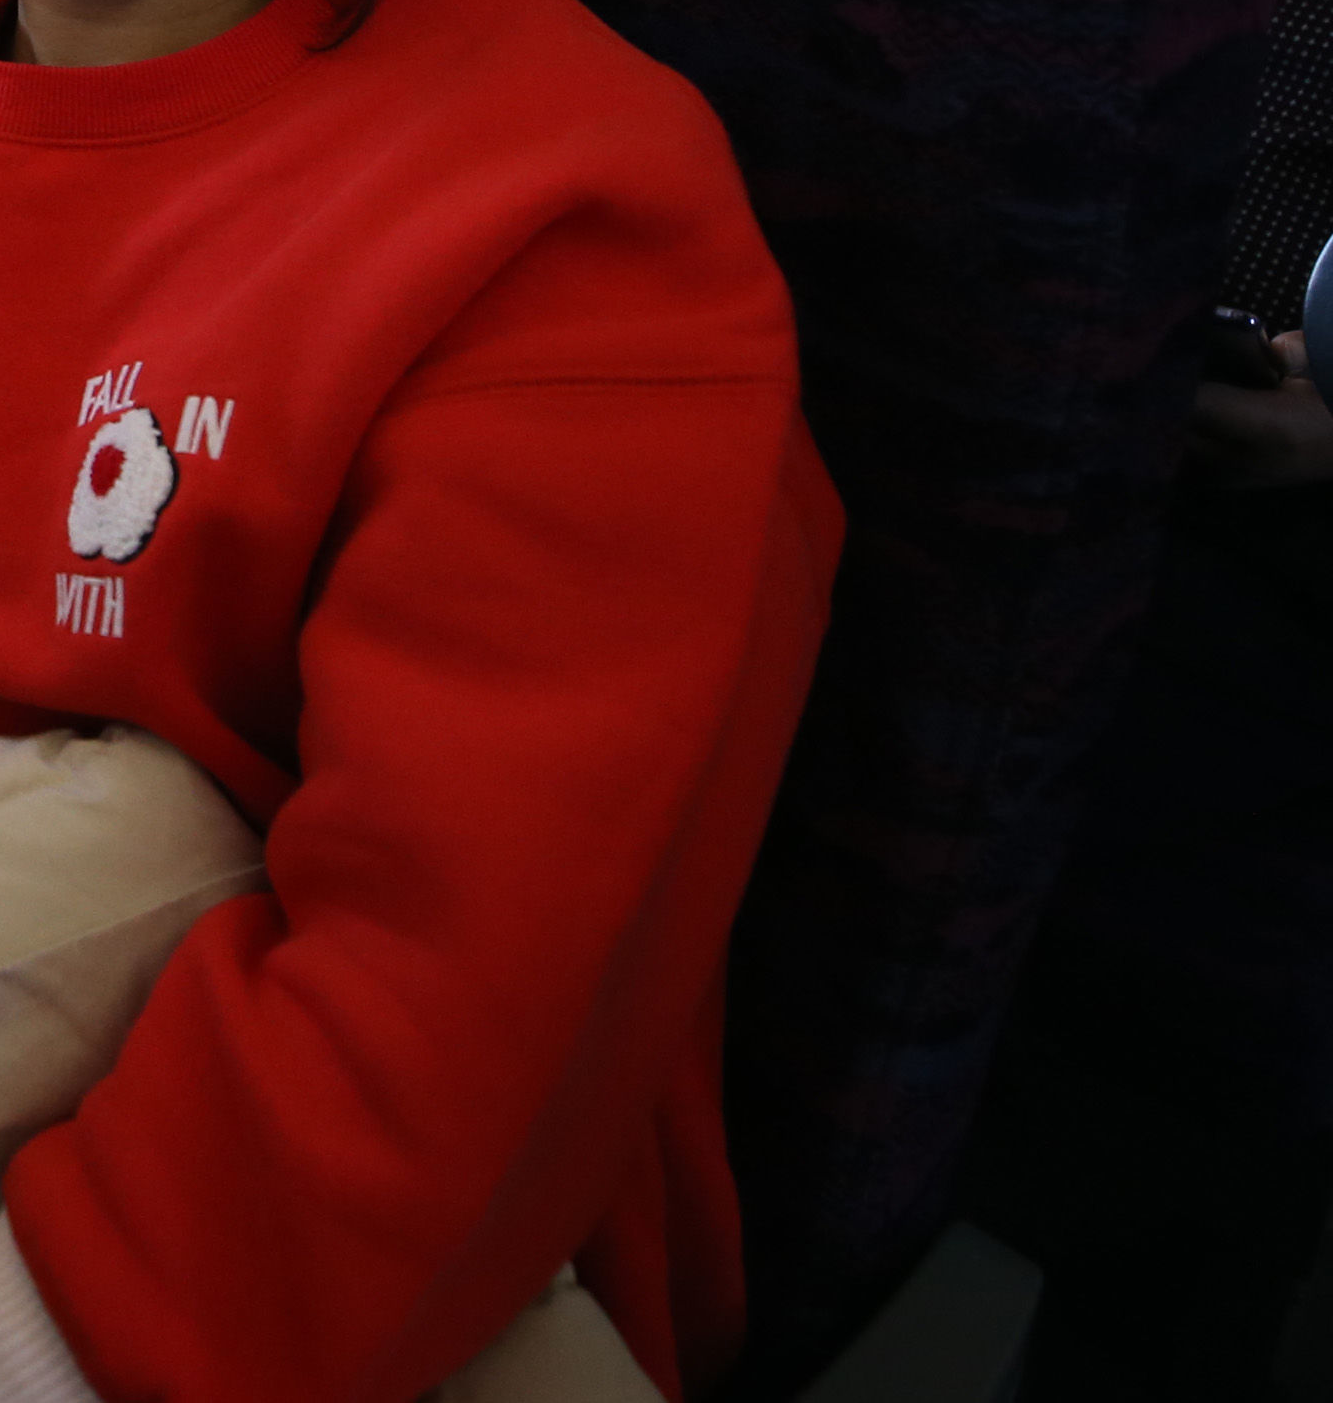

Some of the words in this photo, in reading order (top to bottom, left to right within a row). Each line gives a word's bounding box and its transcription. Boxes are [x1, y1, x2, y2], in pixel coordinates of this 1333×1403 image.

[77, 361, 143, 428] FALL
[174, 395, 235, 461] IN
[54, 571, 125, 639] WITH
